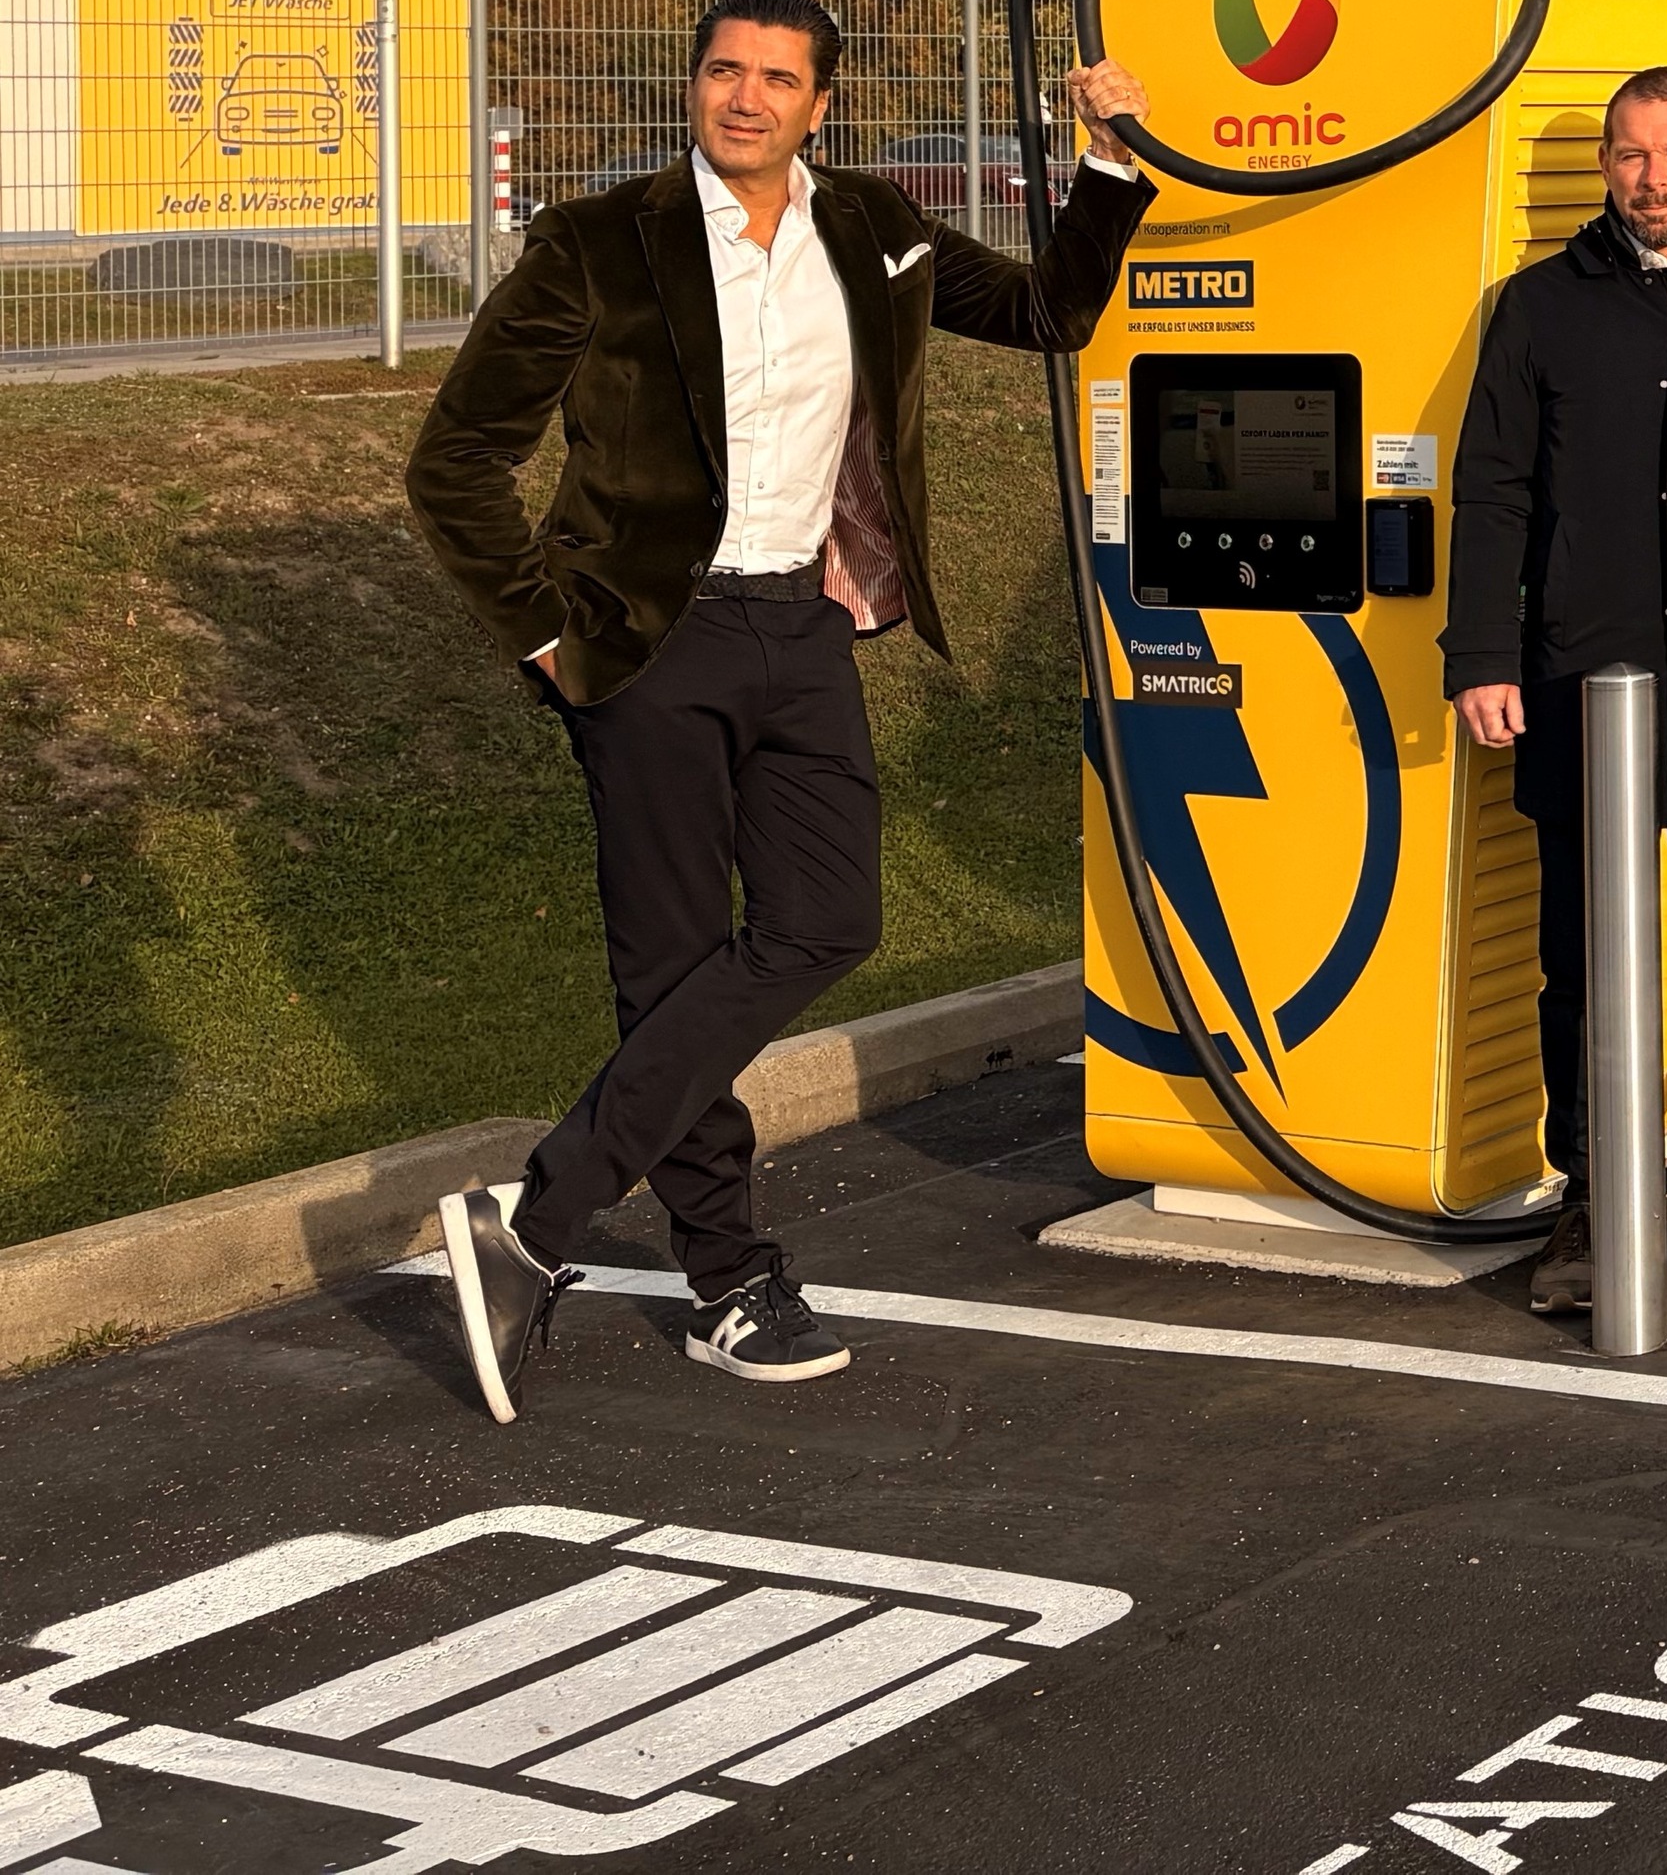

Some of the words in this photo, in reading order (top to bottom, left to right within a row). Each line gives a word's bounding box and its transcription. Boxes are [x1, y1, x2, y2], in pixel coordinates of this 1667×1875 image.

[1213, 101, 1347, 148] amic
[1247, 154, 1312, 169] ENERGY
[156, 194, 211, 215] Jede
[218, 193, 237, 213] 8.
[240, 191, 326, 212] Wäsche
[1143, 221, 1210, 238] Kooperation
[1212, 221, 1231, 235] mit
[1135, 269, 1247, 300] METRO
[1174, 322, 1186, 332] IST
[1187, 321, 1215, 332] UNSER
[1215, 321, 1255, 332] BUSINESS
[1130, 640, 1184, 657] Powered
[1187, 642, 1202, 660] by
